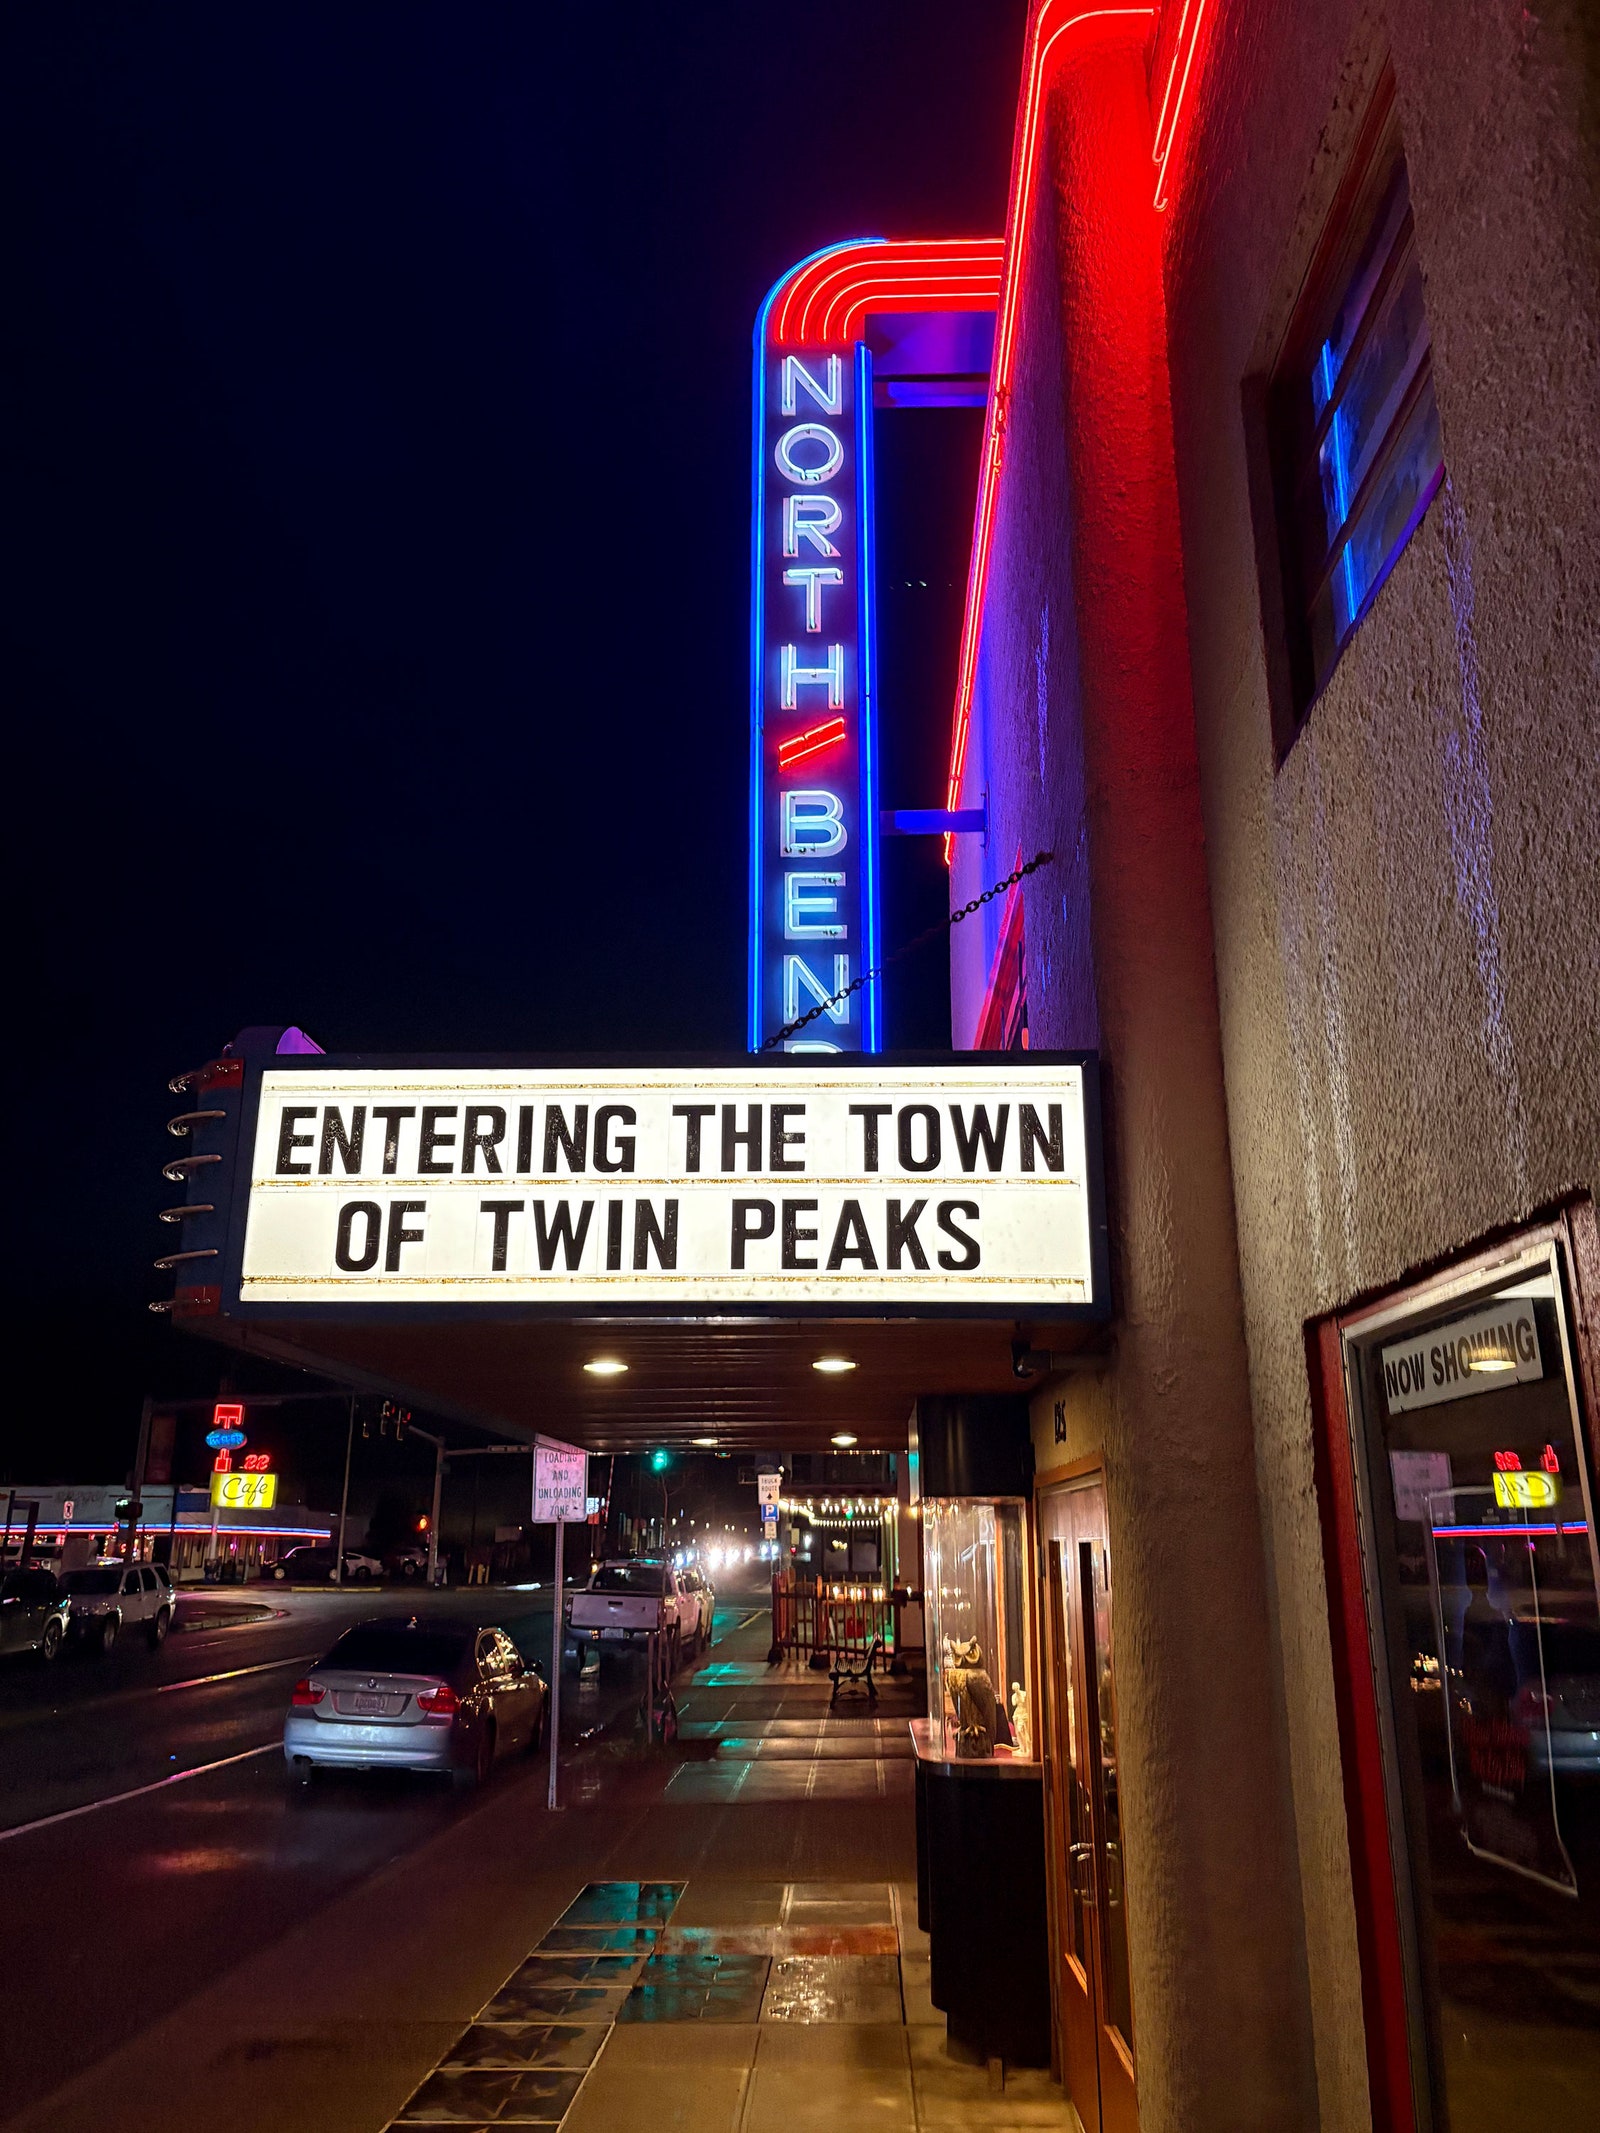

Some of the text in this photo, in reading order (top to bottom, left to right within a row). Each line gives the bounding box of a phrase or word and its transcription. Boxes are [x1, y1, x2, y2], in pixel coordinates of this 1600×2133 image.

[774, 353, 848, 1053] NORTH BEN
[275, 1104, 1065, 1175] ENTERING THE TOWN
[335, 1198, 981, 1272] OF TWIN PEAKS
[1385, 1318, 1537, 1398] NOW SHOWING
[544, 1453, 578, 1464] LOADING
[552, 1470, 569, 1481] AND
[223, 1476, 268, 1506] Cafe
[538, 1487, 582, 1499] UNLOADING
[550, 1505, 570, 1517] ZONE
